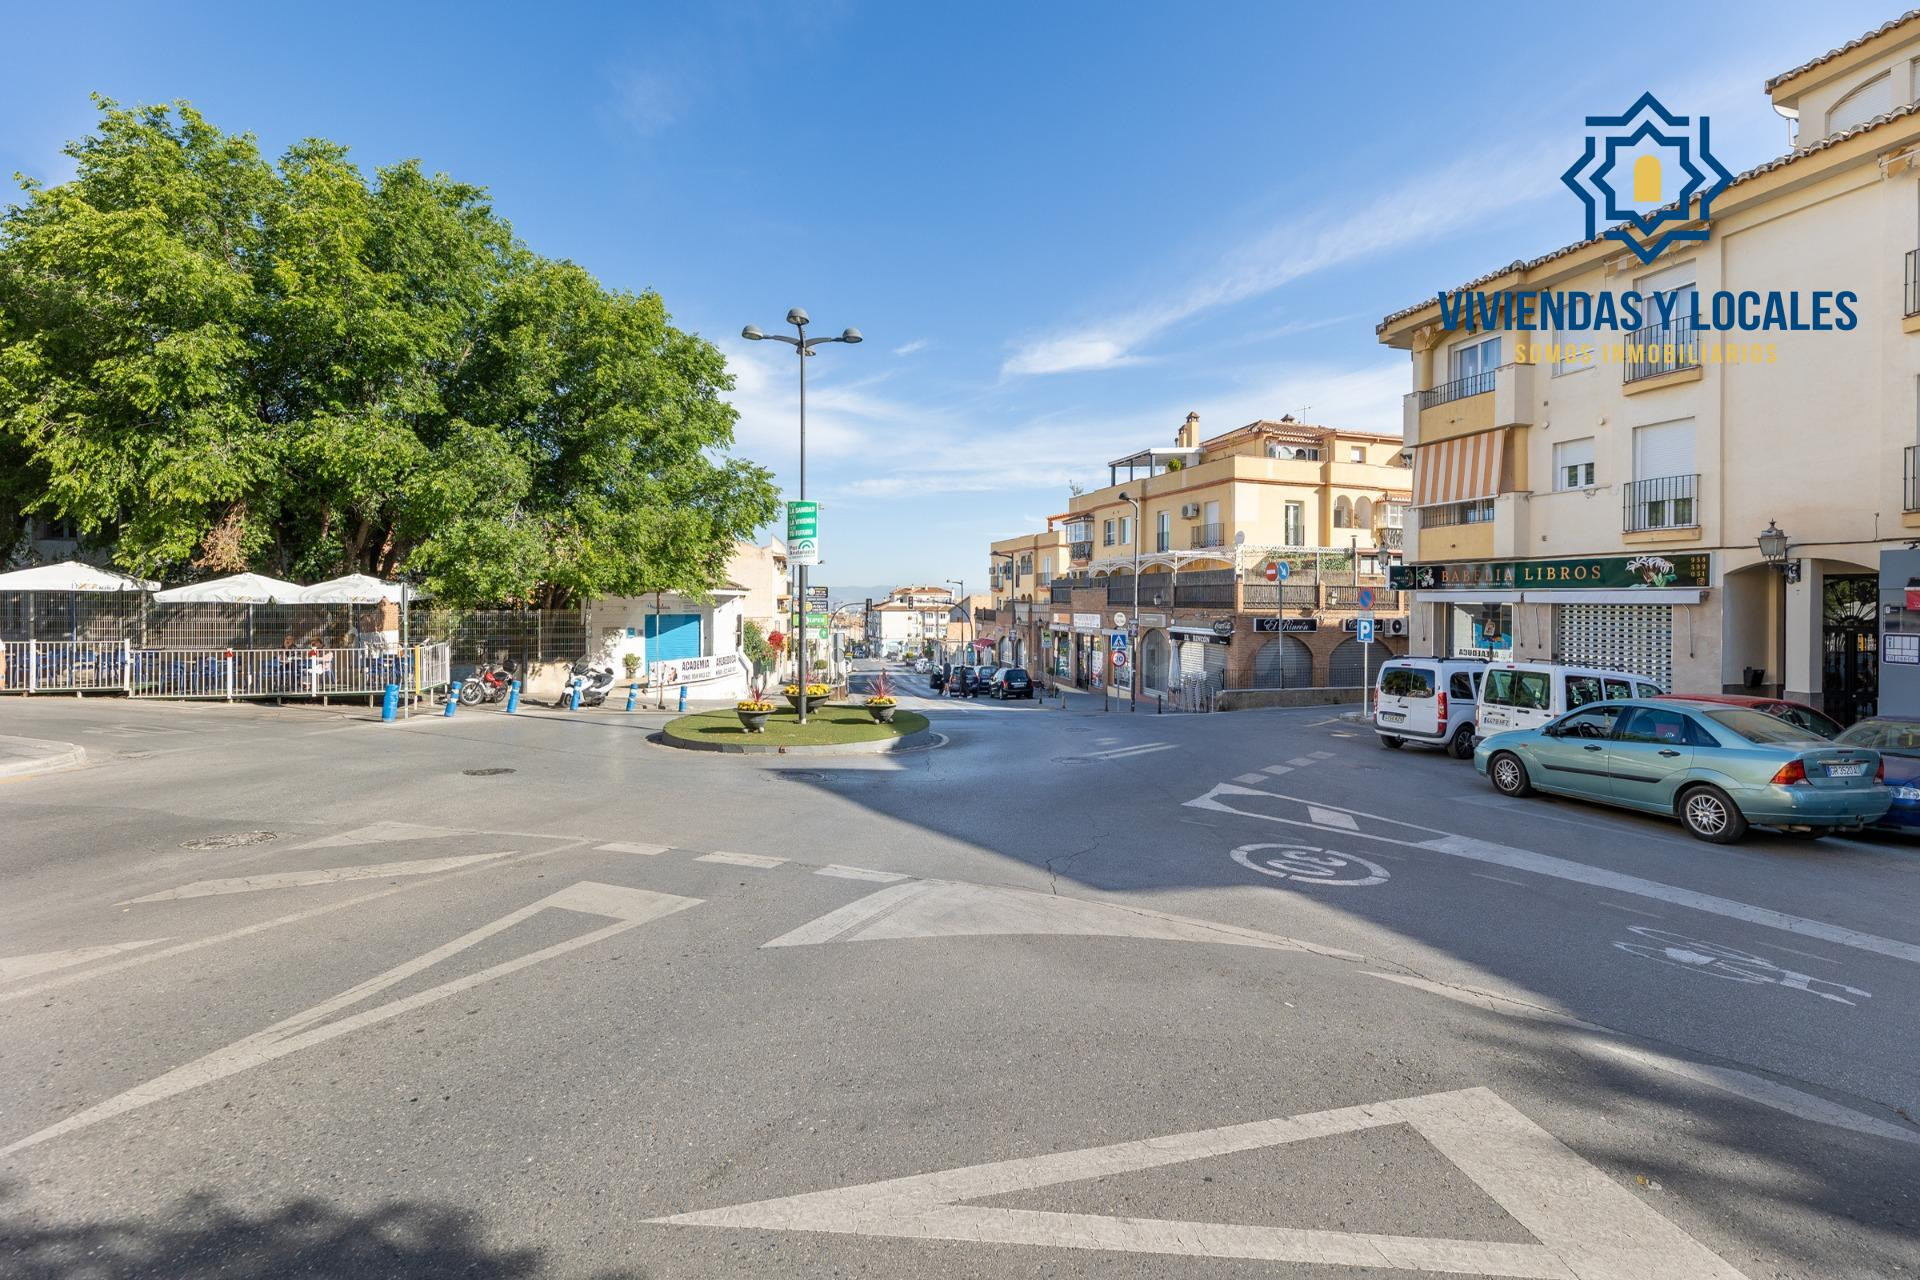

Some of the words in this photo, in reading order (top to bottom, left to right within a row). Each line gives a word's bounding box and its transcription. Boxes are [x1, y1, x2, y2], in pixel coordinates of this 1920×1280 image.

[1441, 567, 1513, 583] BABELIA
[1525, 565, 1600, 581] LIBROS
[1264, 619, 1278, 631] El
[1282, 619, 1309, 631] Rincón
[1360, 621, 1371, 639] P
[681, 659, 710, 671] ACADEMIA
